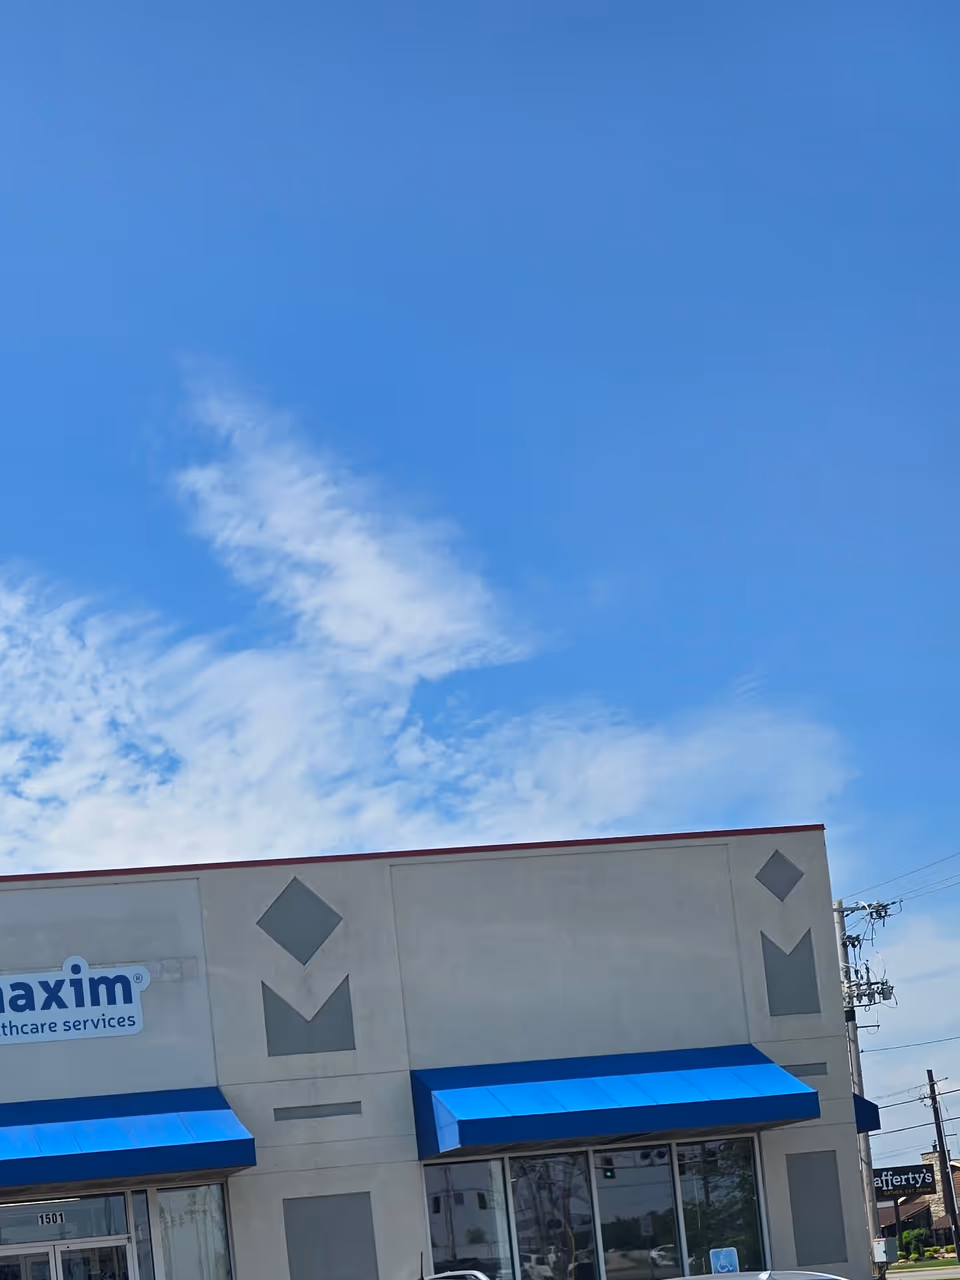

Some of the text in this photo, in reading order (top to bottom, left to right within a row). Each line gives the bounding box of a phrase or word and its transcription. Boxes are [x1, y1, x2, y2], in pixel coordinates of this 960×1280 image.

[62, 1013, 137, 1032] services
[873, 1168, 933, 1190] afferty's
[39, 1212, 64, 1225] 1501
